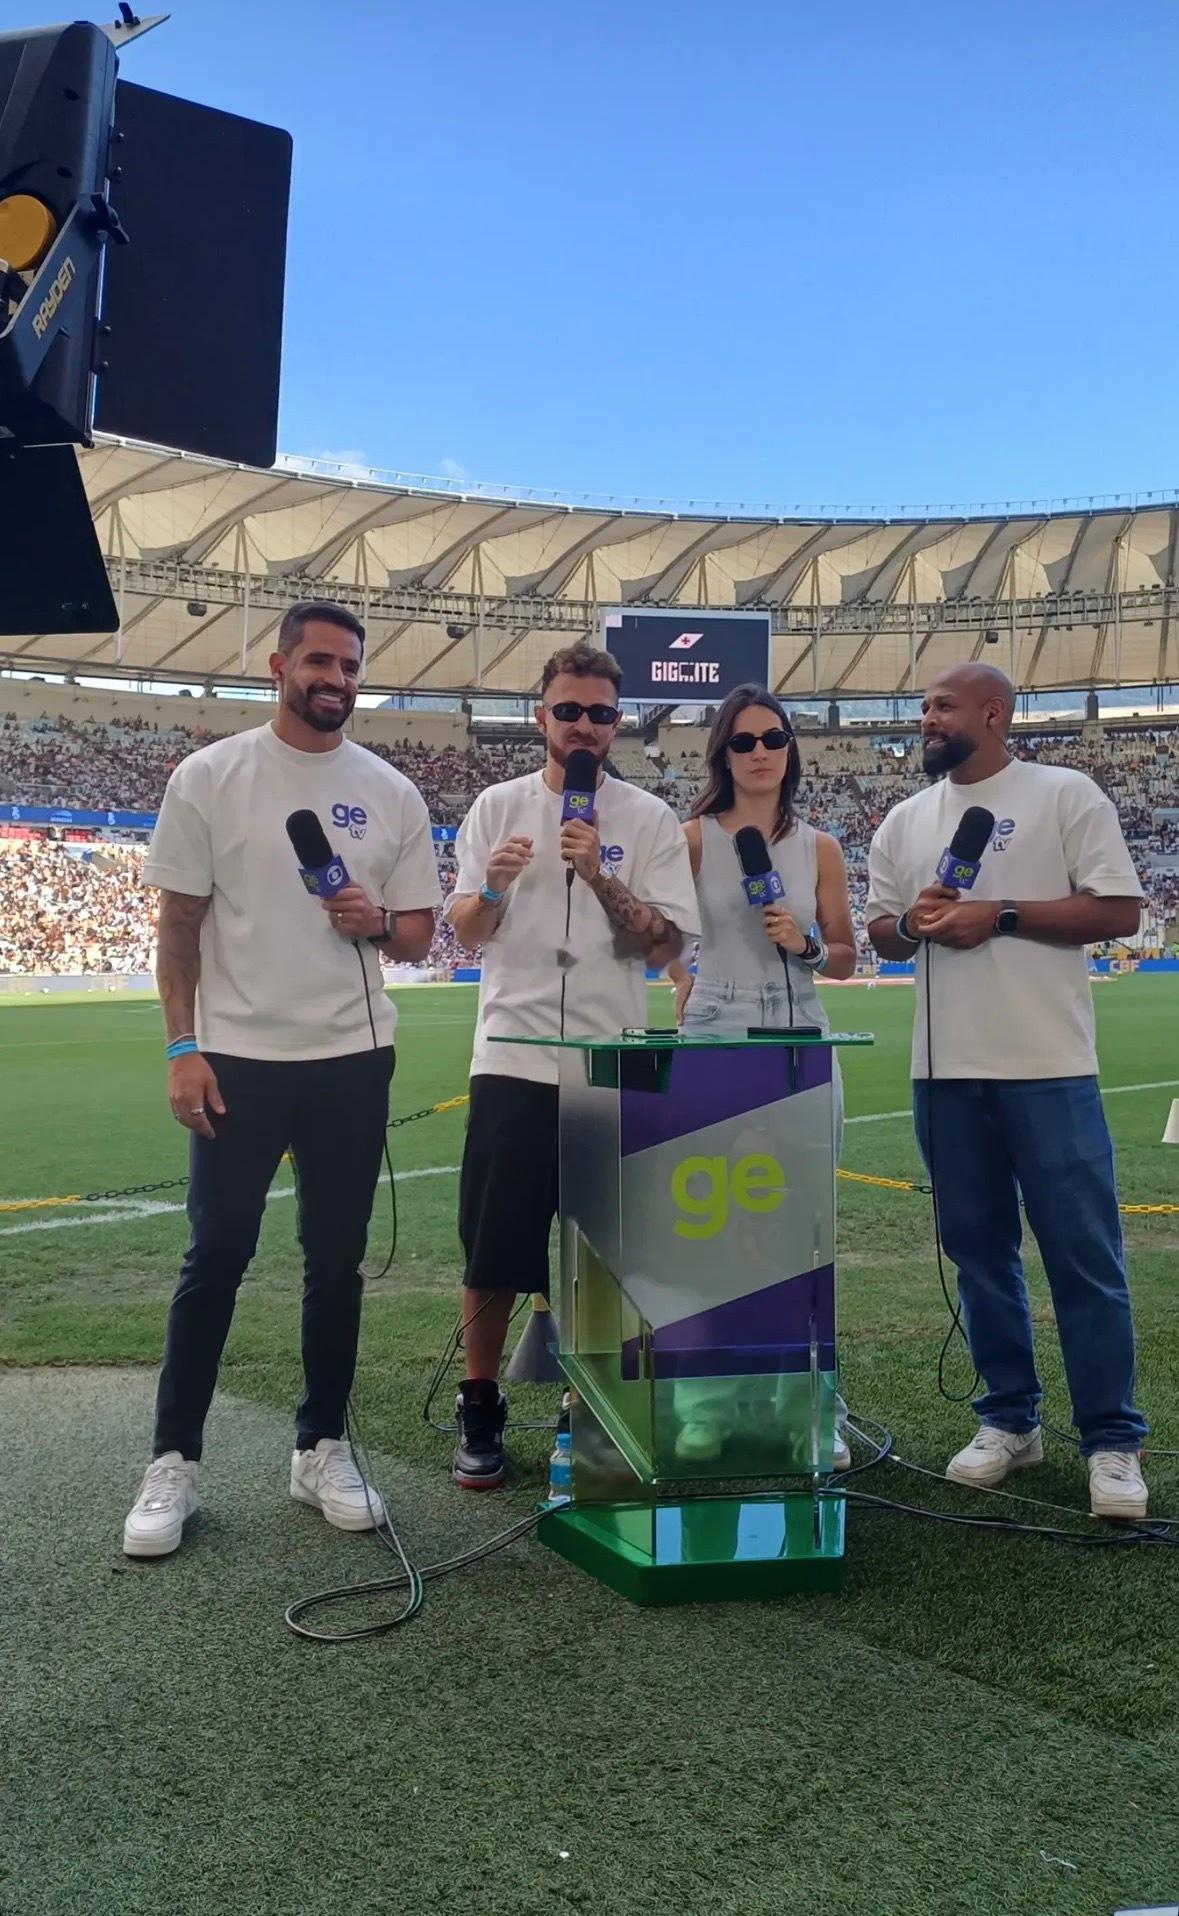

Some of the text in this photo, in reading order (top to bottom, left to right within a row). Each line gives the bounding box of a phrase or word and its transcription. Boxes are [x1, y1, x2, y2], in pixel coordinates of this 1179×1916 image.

[32, 256, 76, 340] RAYDEN
[569, 795, 589, 809] ge
[332, 803, 367, 828] ge
[349, 824, 366, 840] tv
[988, 818, 1015, 843] e
[992, 836, 1013, 852] tv
[953, 865, 974, 879] ge
[671, 1154, 786, 1240] ge
